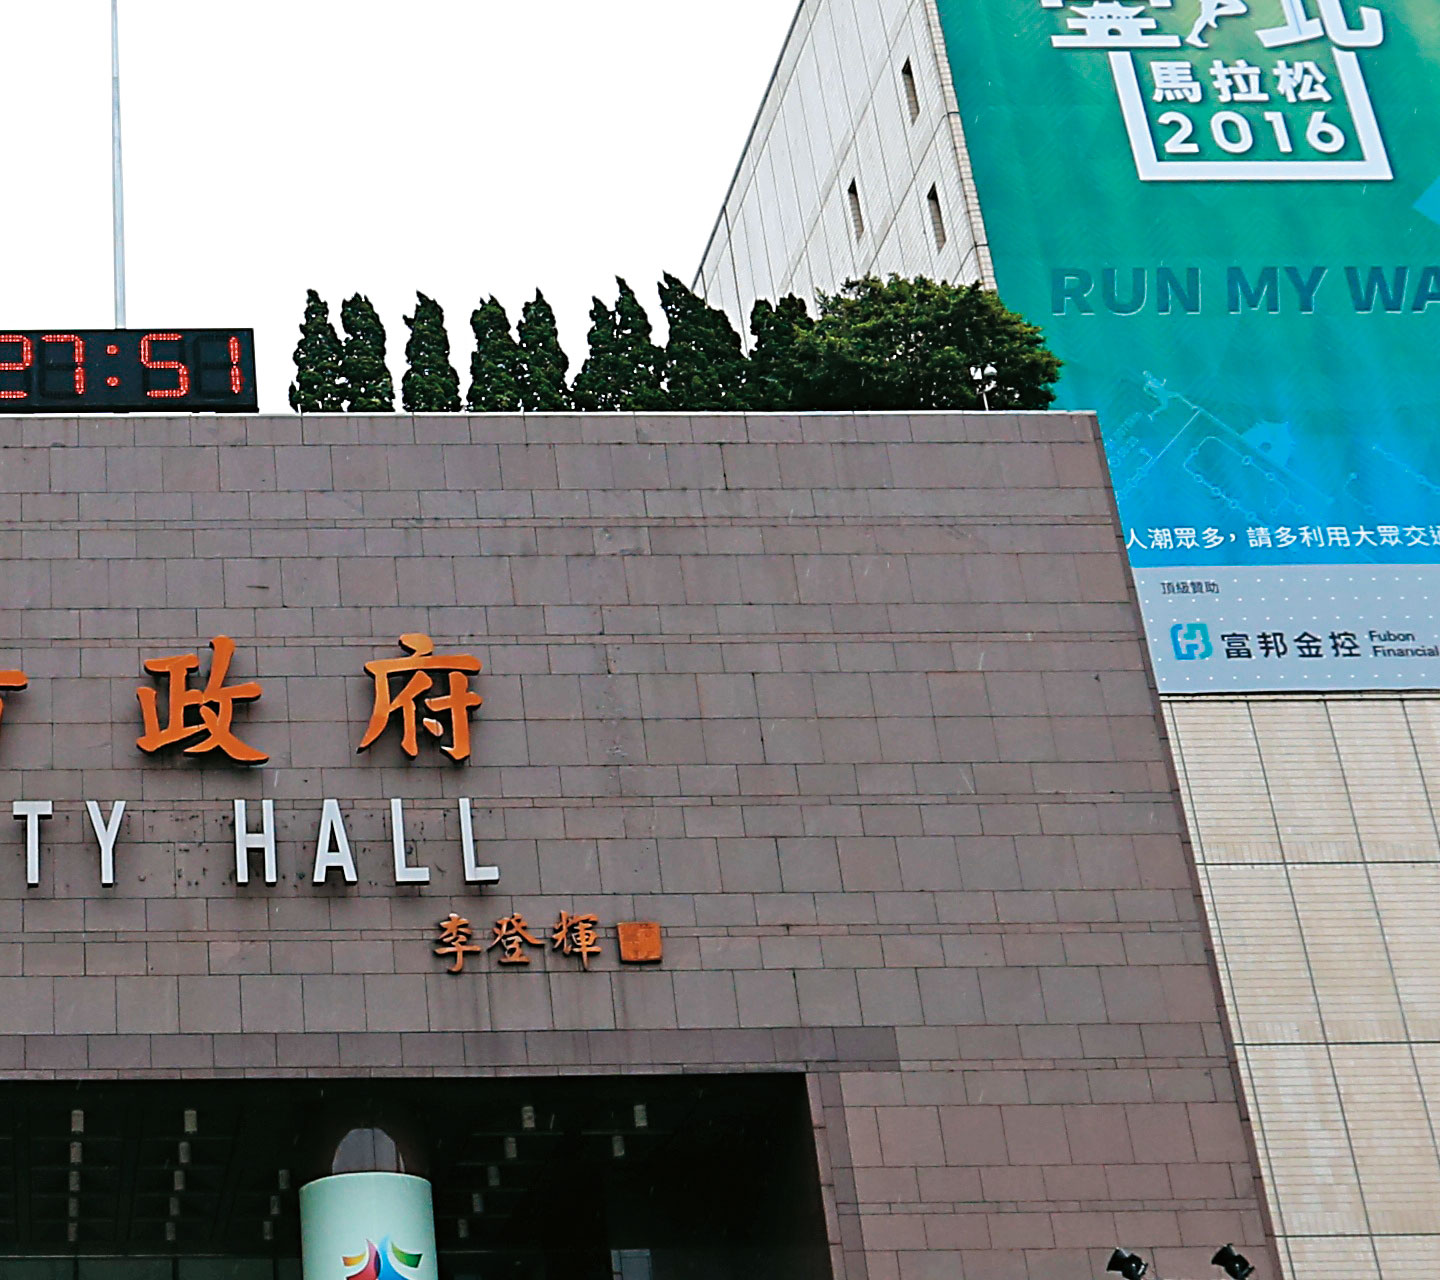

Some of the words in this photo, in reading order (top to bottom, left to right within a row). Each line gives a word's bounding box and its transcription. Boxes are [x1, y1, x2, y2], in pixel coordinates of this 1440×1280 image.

[1150, 60, 1333, 104] 馬拉松
[1156, 111, 1346, 154] 2016
[1051, 266, 1202, 316] RUN
[1227, 266, 1328, 315] MY
[1221, 631, 1362, 659] 富邦金控
[1368, 630, 1415, 642] Fubon
[1372, 645, 1440, 657] Financial
[231, 796, 501, 887] HALL
[433, 910, 603, 974] 李登輝
